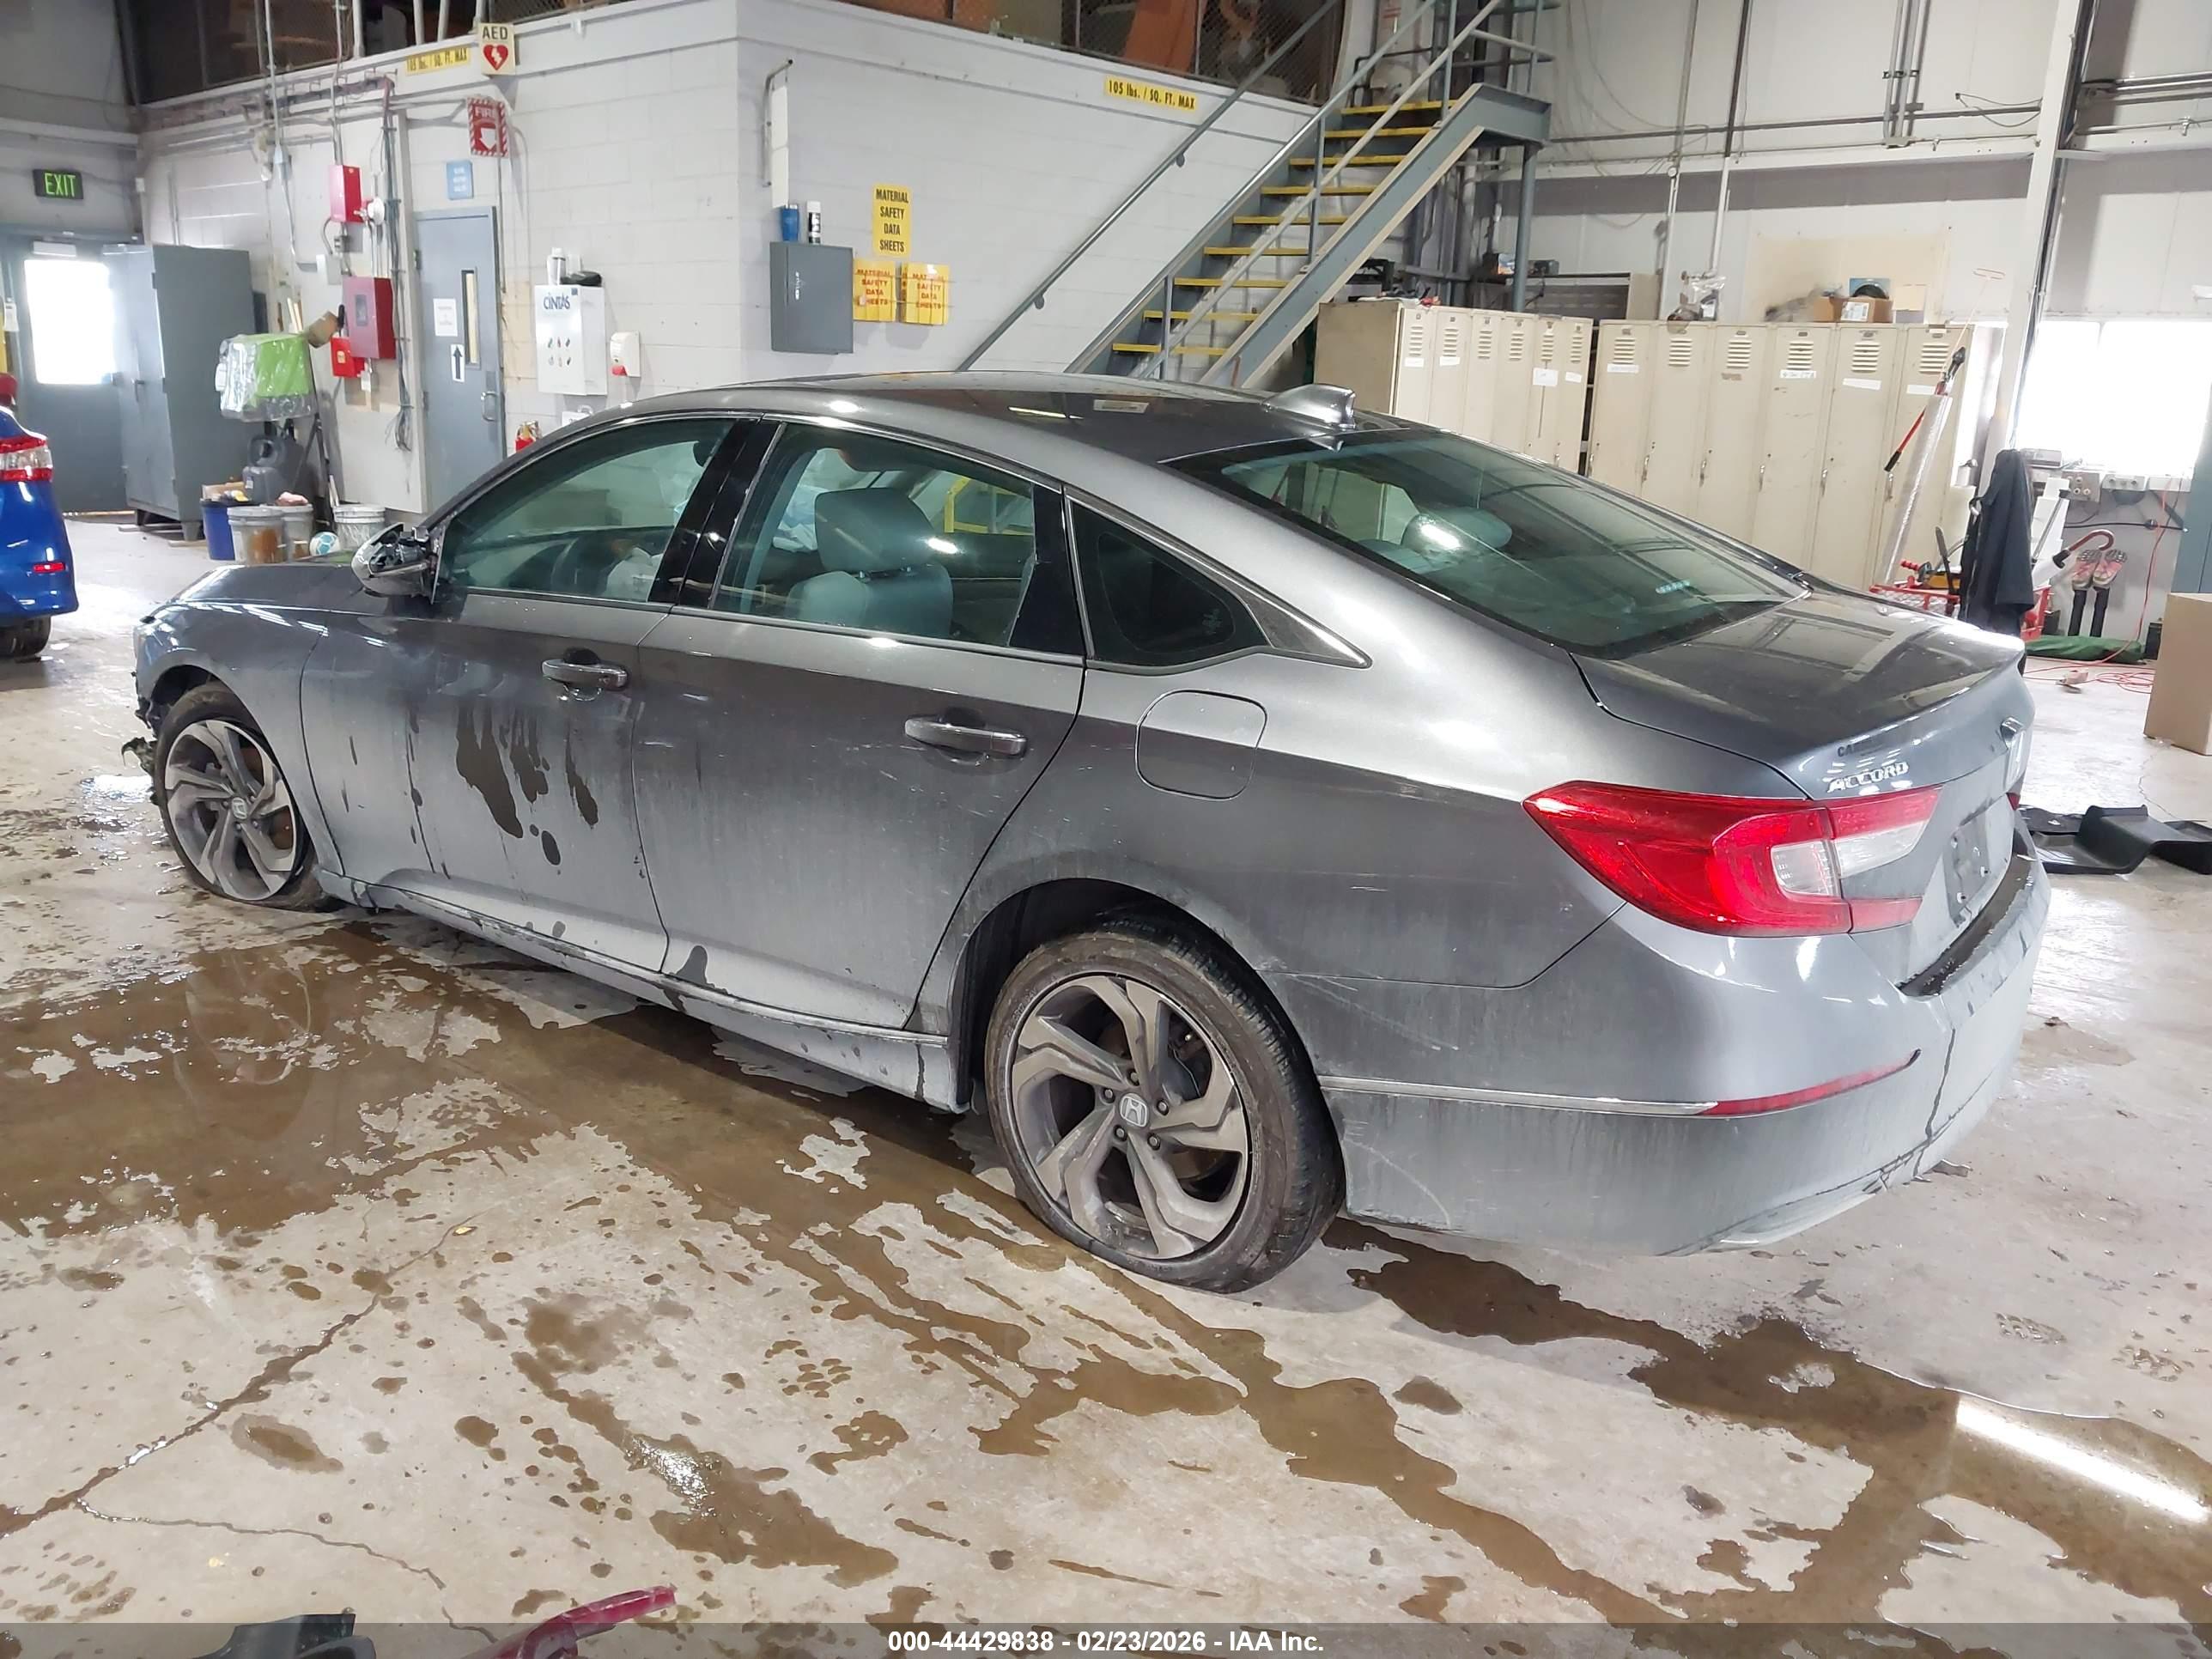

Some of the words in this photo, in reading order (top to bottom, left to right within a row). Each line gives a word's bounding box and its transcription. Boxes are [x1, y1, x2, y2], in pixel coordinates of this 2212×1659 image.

[483, 26, 508, 40] AED
[1109, 80, 1123, 94] 105
[1127, 82, 1140, 98] lbs.
[1150, 88, 1161, 102] SQ.
[1165, 92, 1176, 106] FT.
[1178, 94, 1194, 109] MAX
[45, 173, 76, 198] EXIT
[876, 188, 908, 204] MATERIAL
[880, 206, 904, 220] SAFETY
[884, 222, 901, 235] DATA
[879, 240, 904, 252] SHEETS
[544, 293, 570, 310] CINTAS
[1826, 762, 1909, 793] ACCORD
